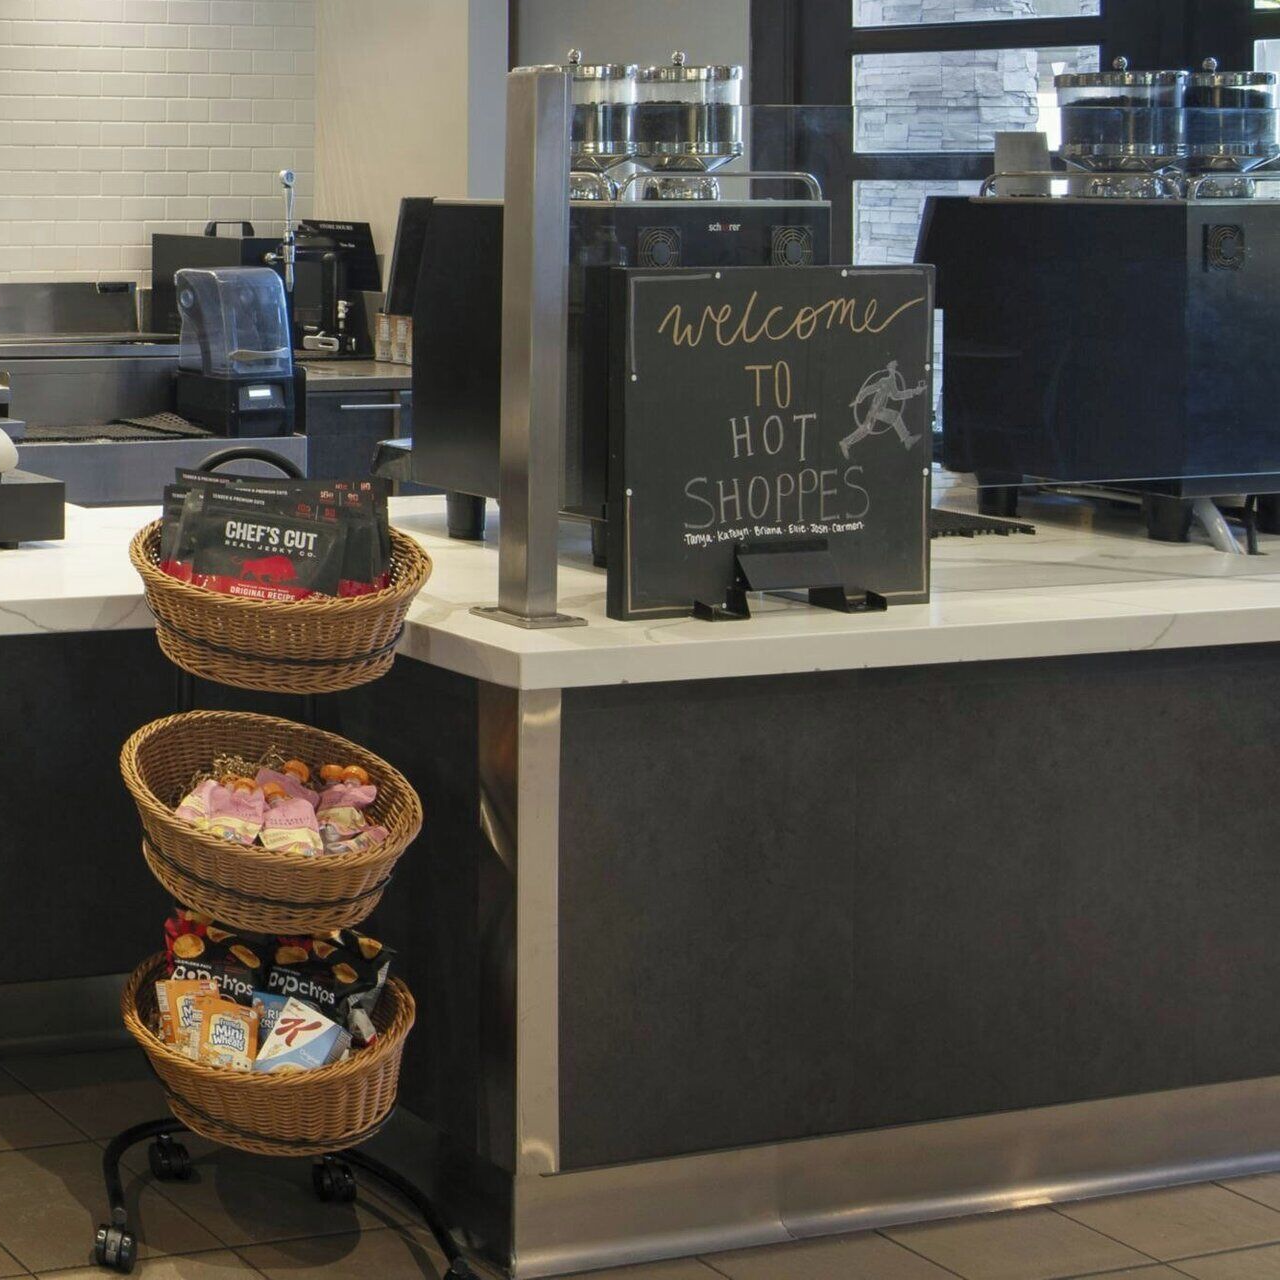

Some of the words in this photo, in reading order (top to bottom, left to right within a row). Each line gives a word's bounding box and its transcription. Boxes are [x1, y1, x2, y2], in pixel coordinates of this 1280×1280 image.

[657, 290, 926, 347] welcome
[744, 360, 791, 409] TO
[728, 412, 817, 462] HOT
[233, 496, 253, 504] PREMIUM
[683, 465, 871, 530] SHOPPES
[225, 520, 281, 546] CHEF'S
[283, 529, 318, 551] CUT
[753, 524, 783, 537] Briana
[810, 522, 829, 534] Josh
[832, 521, 864, 534] Carmen
[224, 540, 253, 550] REAL
[257, 545, 294, 555] JERKY
[298, 551, 317, 559] CO.
[229, 585, 266, 599] ORIGINAL
[267, 591, 296, 602] RECIPE
[170, 965, 254, 997] popchips
[269, 971, 336, 1006] popchips
[212, 1033, 247, 1052] Wheats
[214, 1023, 244, 1041] Mini
